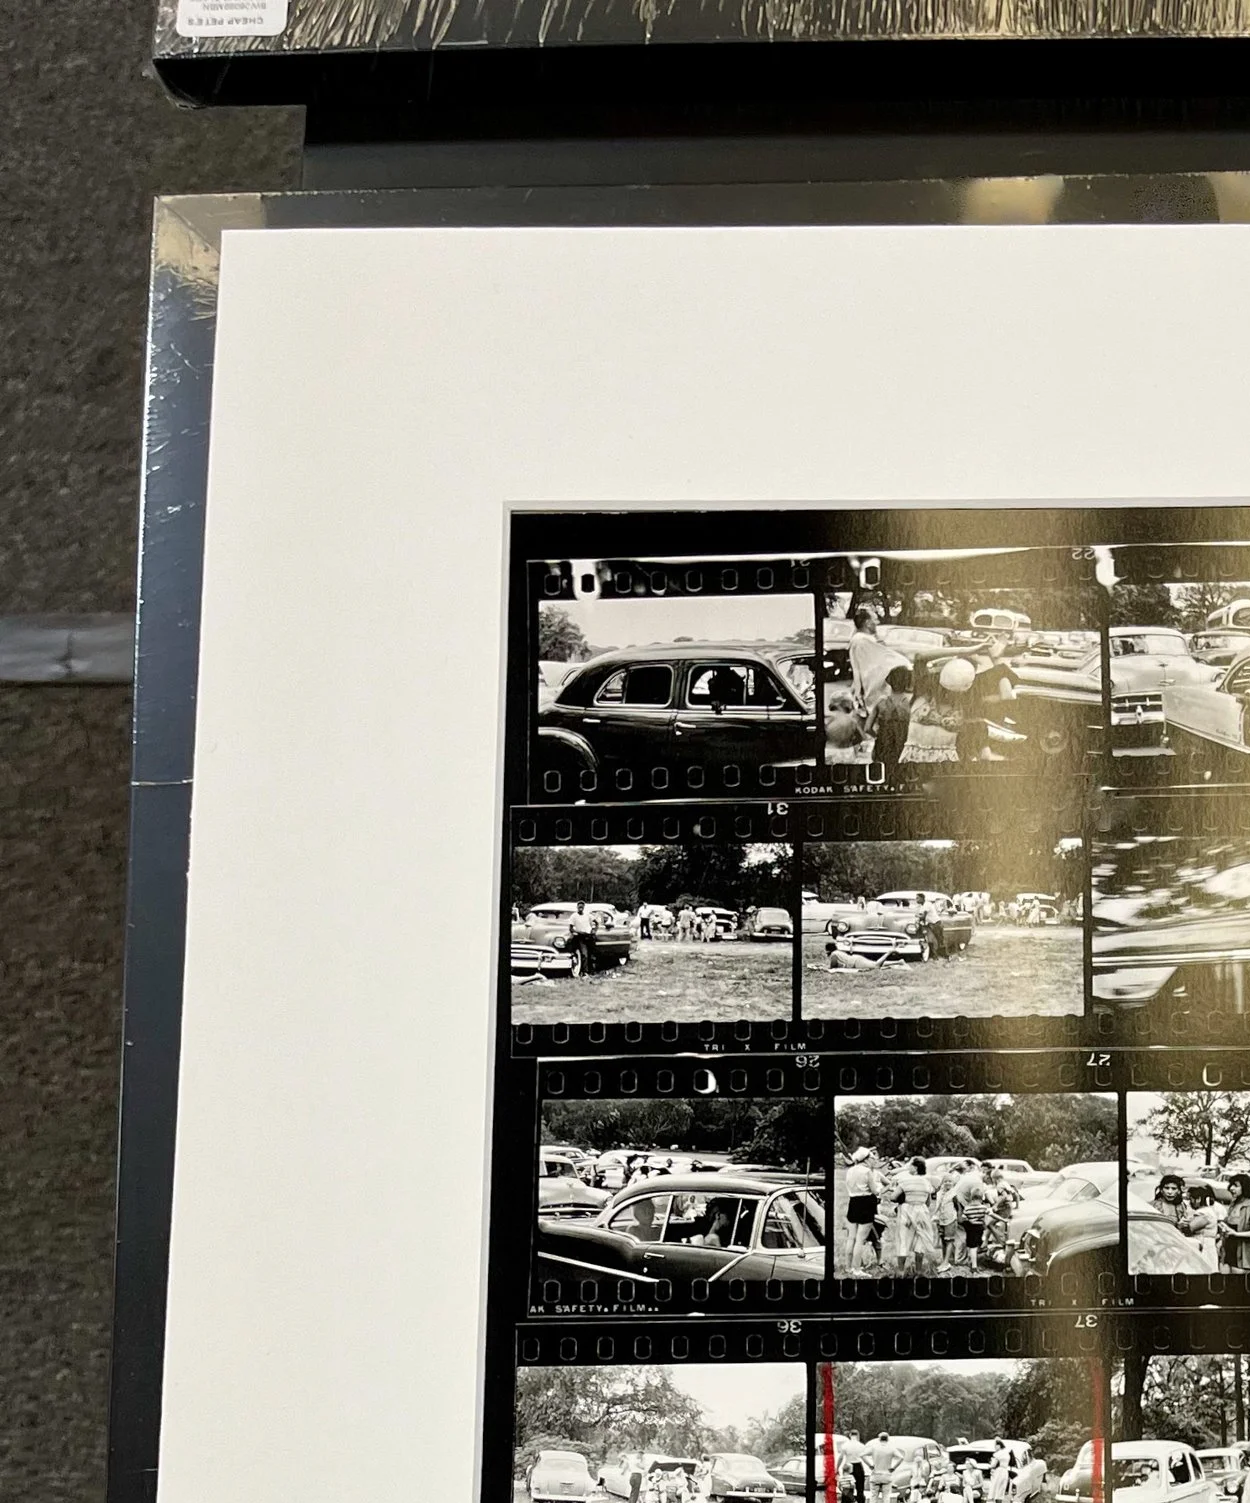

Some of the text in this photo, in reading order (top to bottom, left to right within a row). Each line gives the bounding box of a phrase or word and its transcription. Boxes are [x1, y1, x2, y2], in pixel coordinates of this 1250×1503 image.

[1072, 547, 1095, 560] 22
[795, 786, 834, 795] KODAK
[767, 802, 789, 815] 31
[774, 1042, 807, 1051] FILM
[795, 1054, 820, 1068] 26
[1086, 1053, 1111, 1066] 27
[1101, 1298, 1135, 1306] FILM
[777, 1320, 802, 1333] 36
[1074, 1314, 1098, 1328] 37
